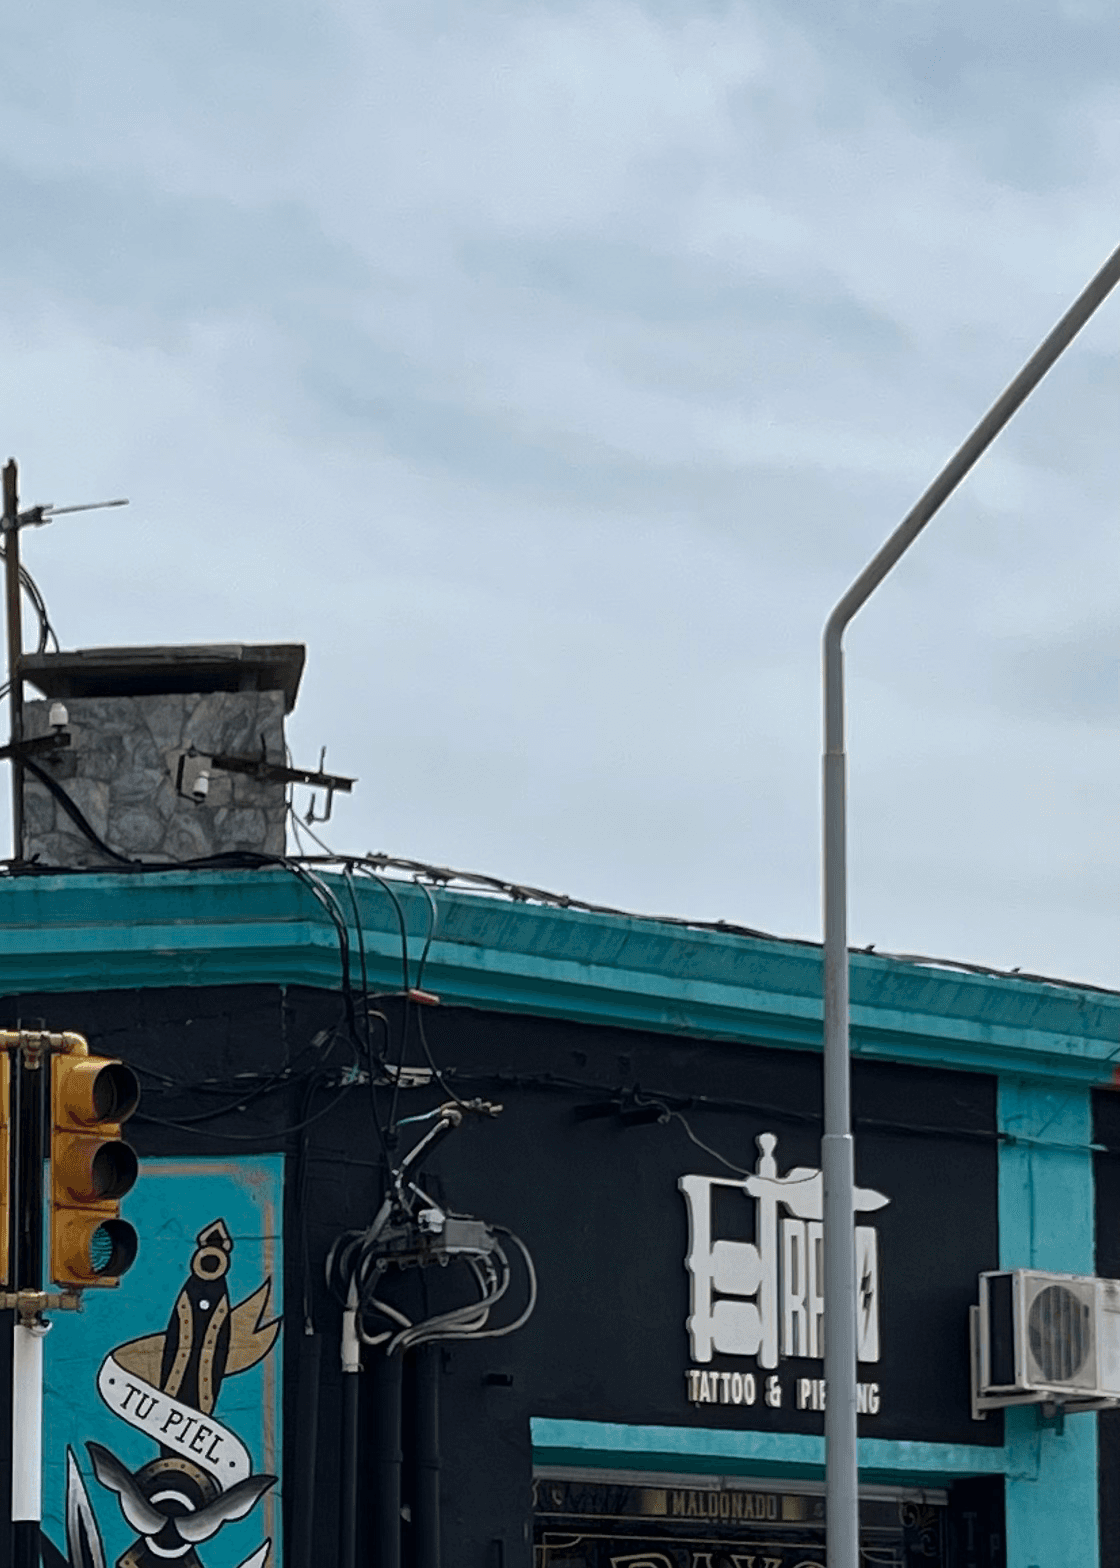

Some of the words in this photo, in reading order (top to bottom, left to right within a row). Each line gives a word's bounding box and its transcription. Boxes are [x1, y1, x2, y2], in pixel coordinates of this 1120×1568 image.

[685, 1369, 756, 1406] TATTOO
[764, 1375, 782, 1409] &
[797, 1378, 879, 1414] PIENG
[120, 1382, 159, 1420] TU
[160, 1408, 224, 1464] PIEL
[671, 1490, 779, 1520] MALDONADO
